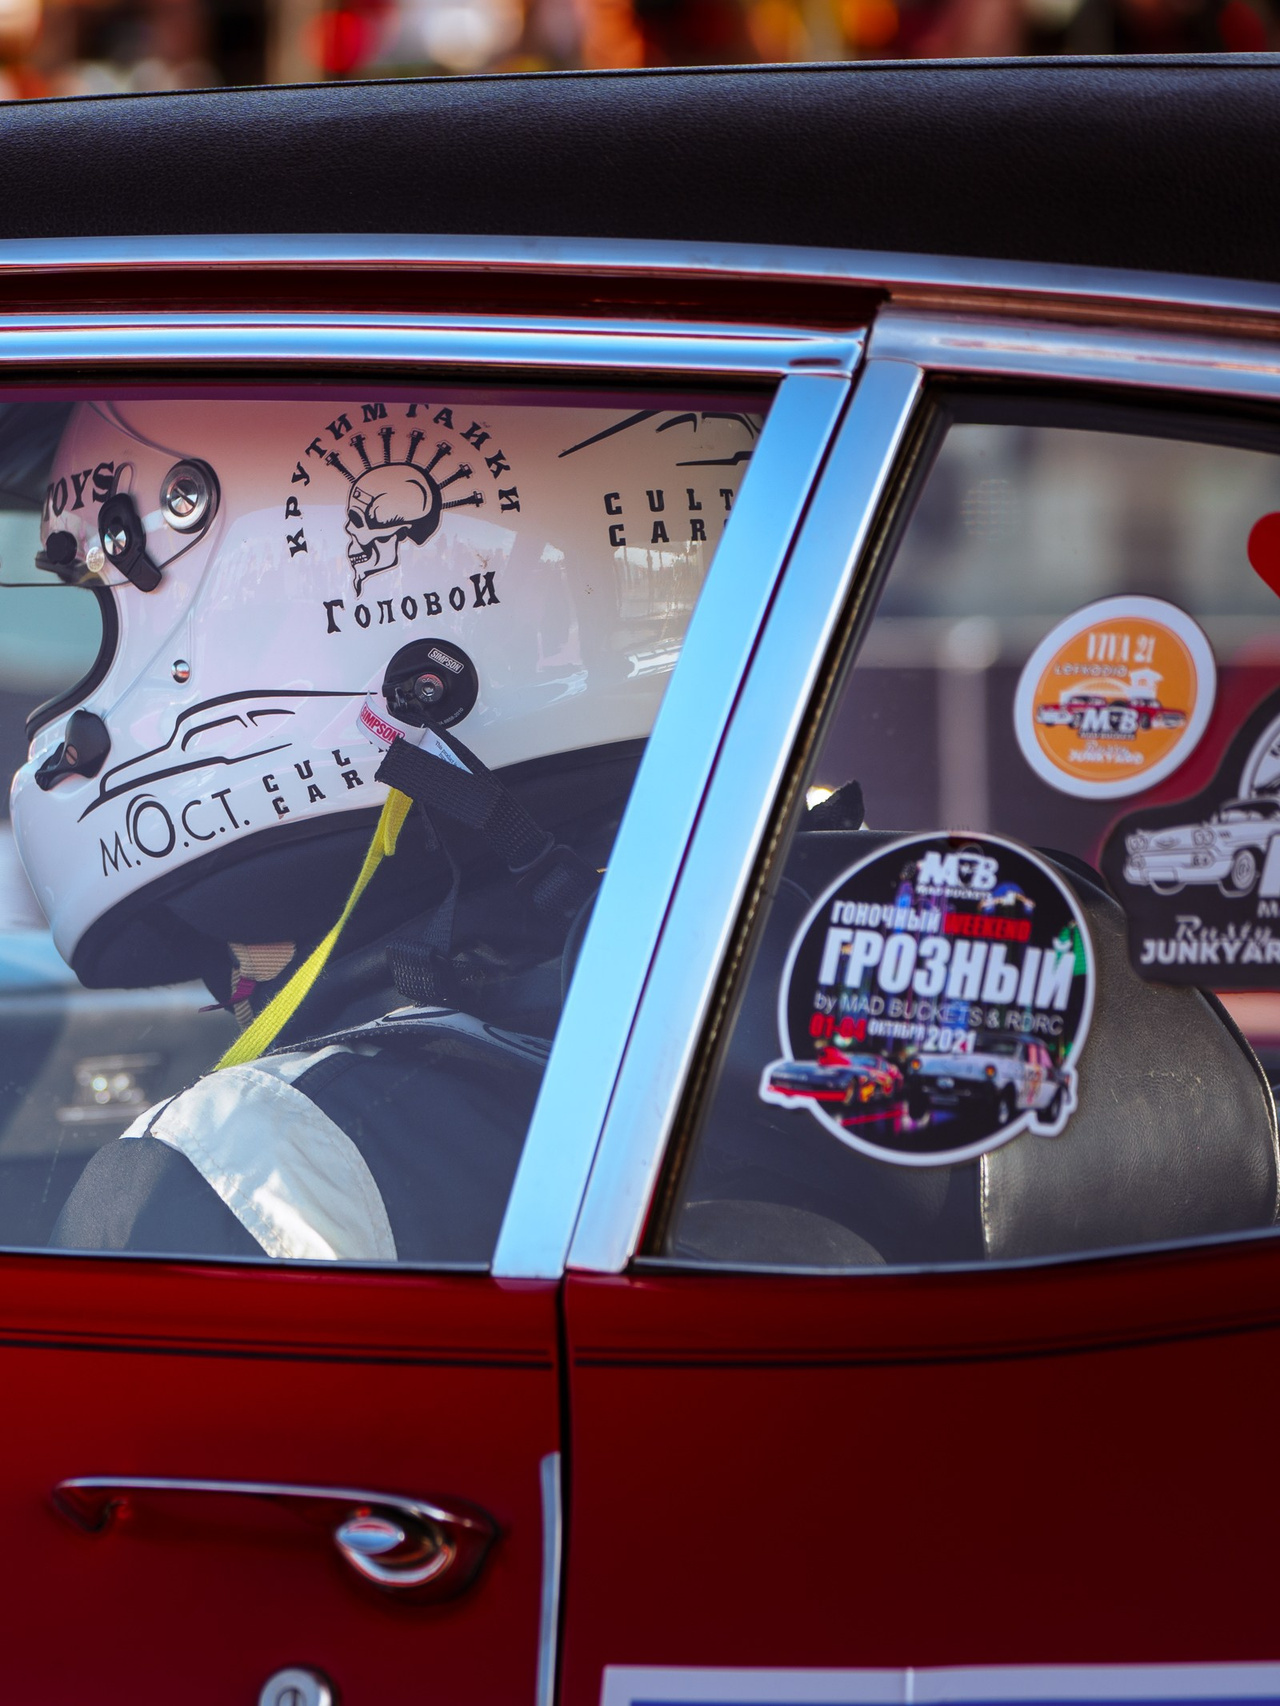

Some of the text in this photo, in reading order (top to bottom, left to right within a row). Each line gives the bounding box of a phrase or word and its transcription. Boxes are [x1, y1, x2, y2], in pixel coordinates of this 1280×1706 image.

[603, 488, 734, 516] CULT
[608, 518, 729, 547] CAR
[429, 649, 462, 673] SIMPSON
[360, 705, 402, 743] SIMPSON
[261, 741, 390, 793] CUL
[830, 900, 1032, 943] ГОНОЧНЫЙ WEEKEND
[818, 926, 1076, 1011] ГРОЗНЫЙ
[809, 1012, 867, 1043] 01-04
[923, 1026, 977, 1054] 2021
[813, 993, 1065, 1036] by MAD BUCKETS & RDRC
